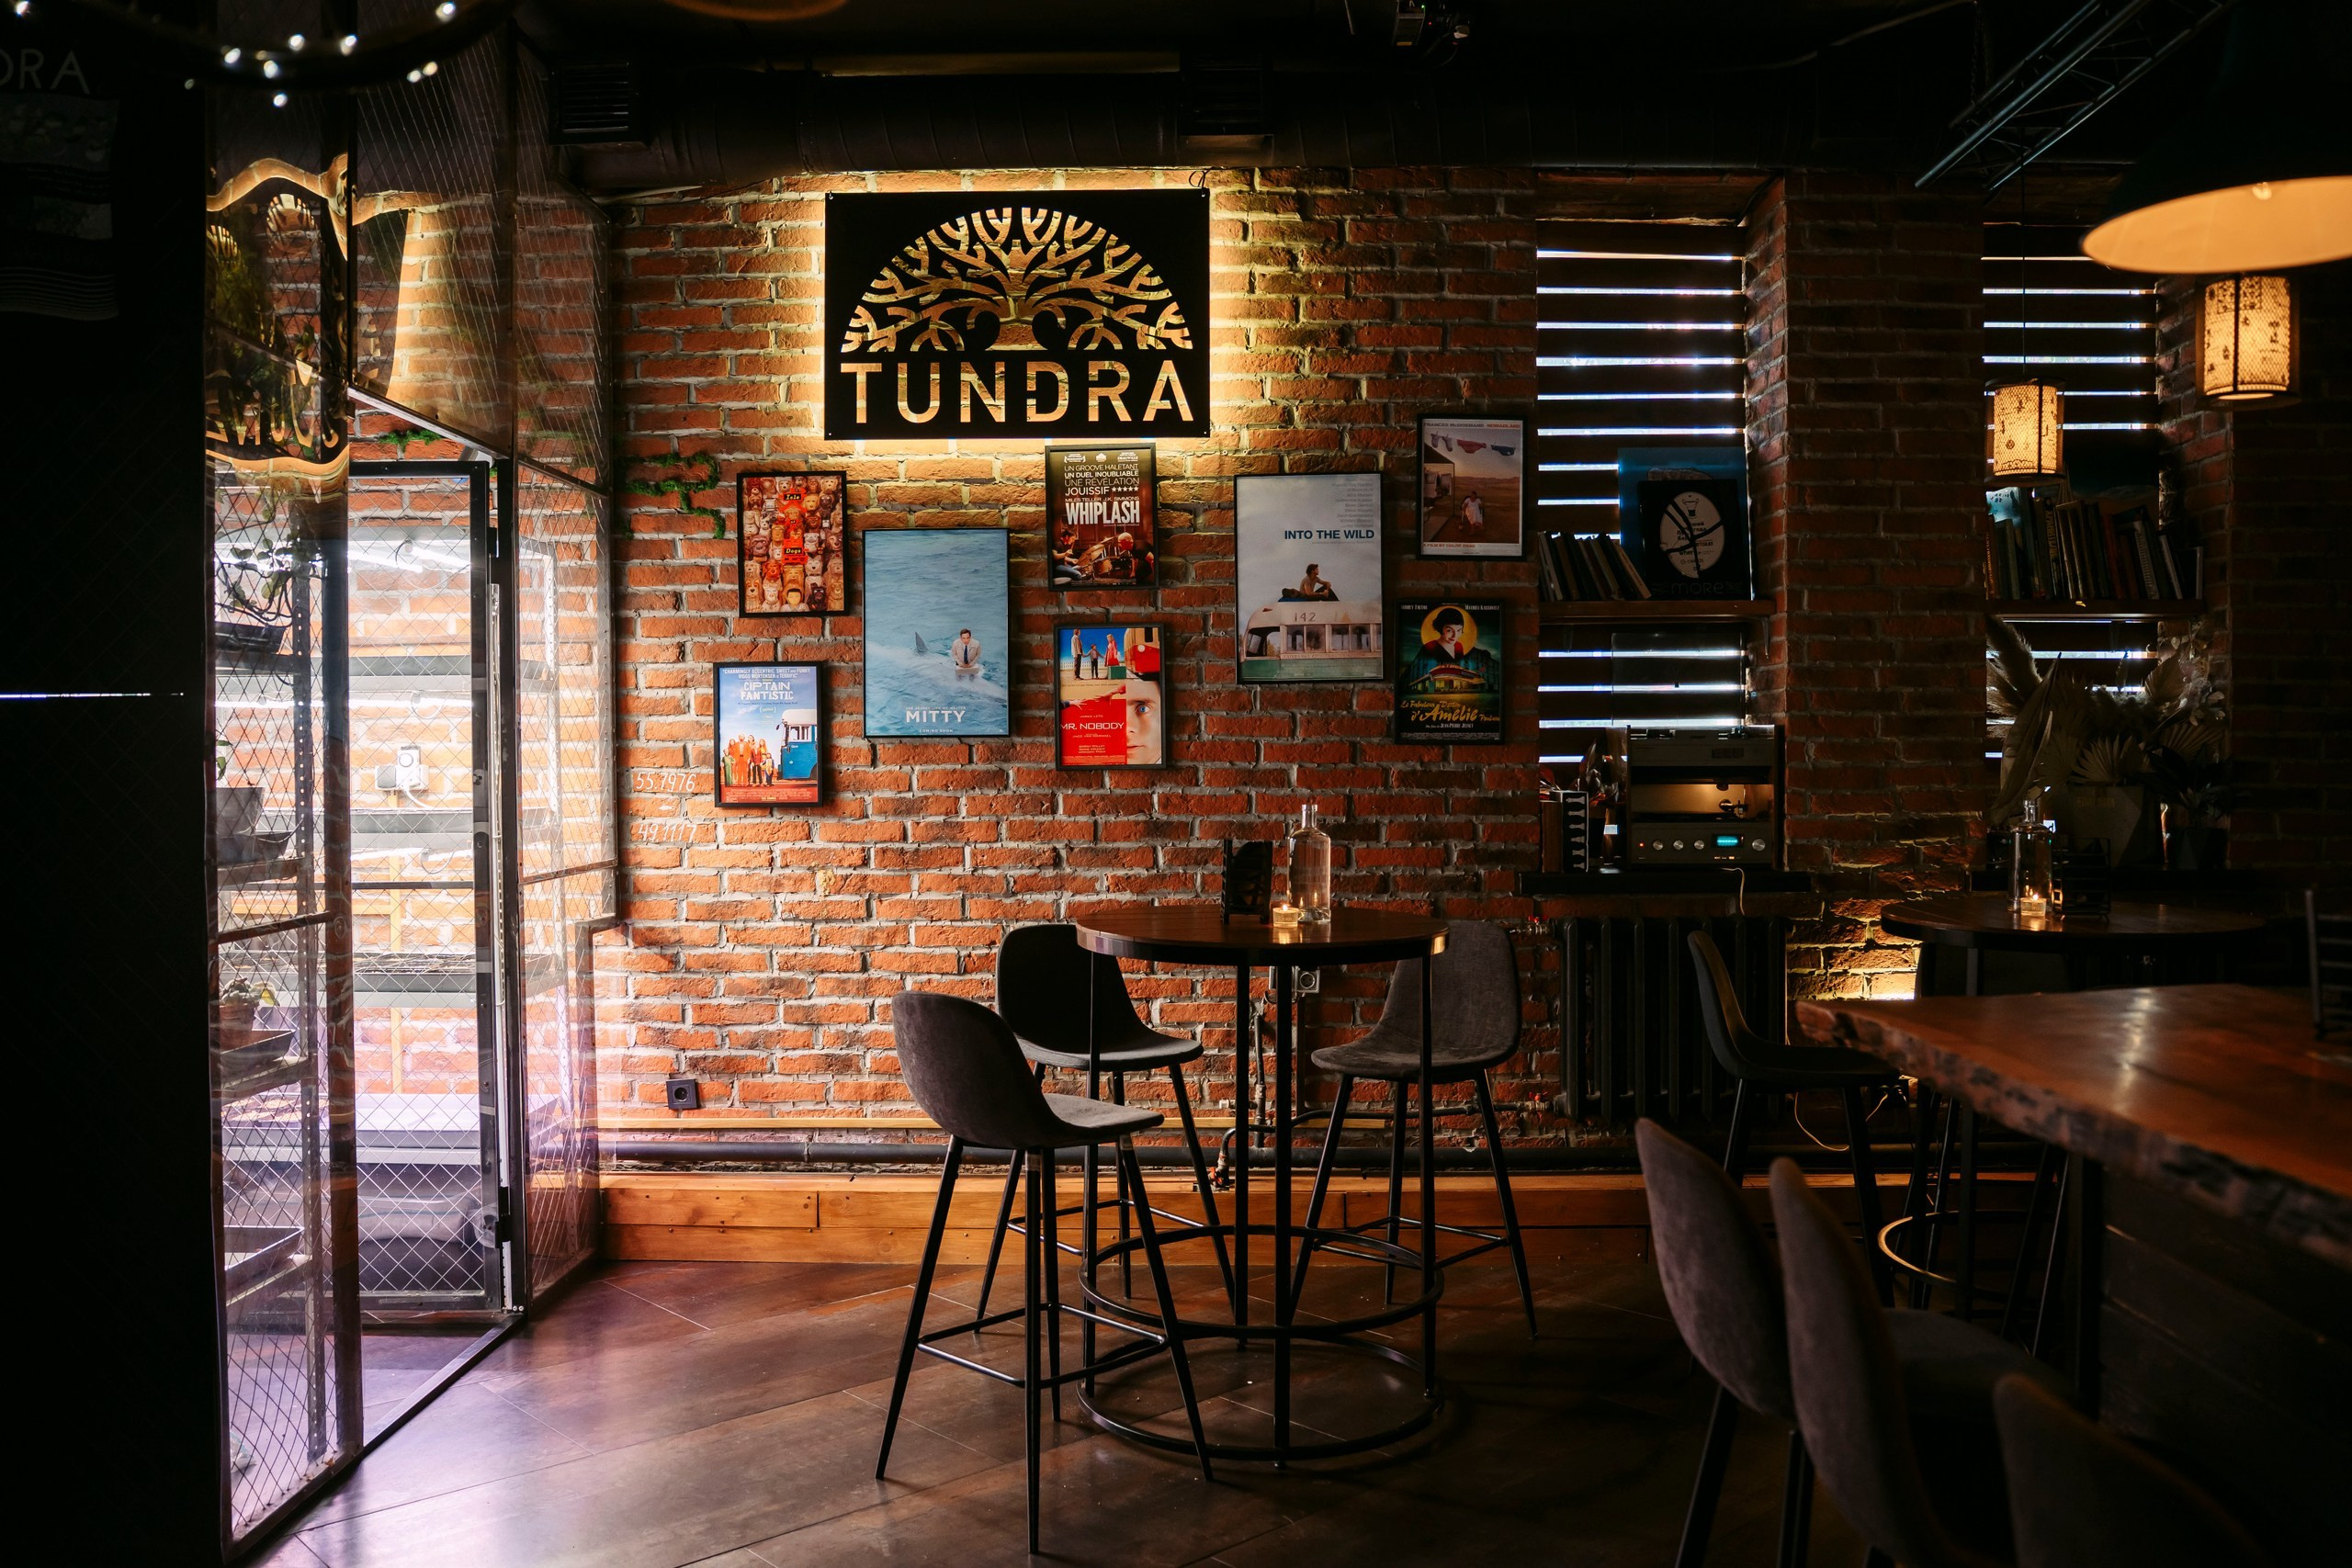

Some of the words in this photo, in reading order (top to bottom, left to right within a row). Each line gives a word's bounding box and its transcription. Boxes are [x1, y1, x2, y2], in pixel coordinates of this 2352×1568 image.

[840, 360, 1194, 423] TUNDRA
[1064, 479, 1083, 487] UNE
[1065, 486, 1110, 496] JOUISSIF
[1065, 501, 1140, 525] WHIPLASH
[1284, 530, 1313, 540] INTO
[1316, 530, 1340, 539] THE
[1343, 529, 1375, 539] WILD
[1295, 612, 1317, 623] 142
[906, 710, 966, 723] MITTY
[1080, 722, 1125, 730] NOBODY
[636, 771, 696, 792] 55.7976
[638, 823, 697, 843] 49.1117
